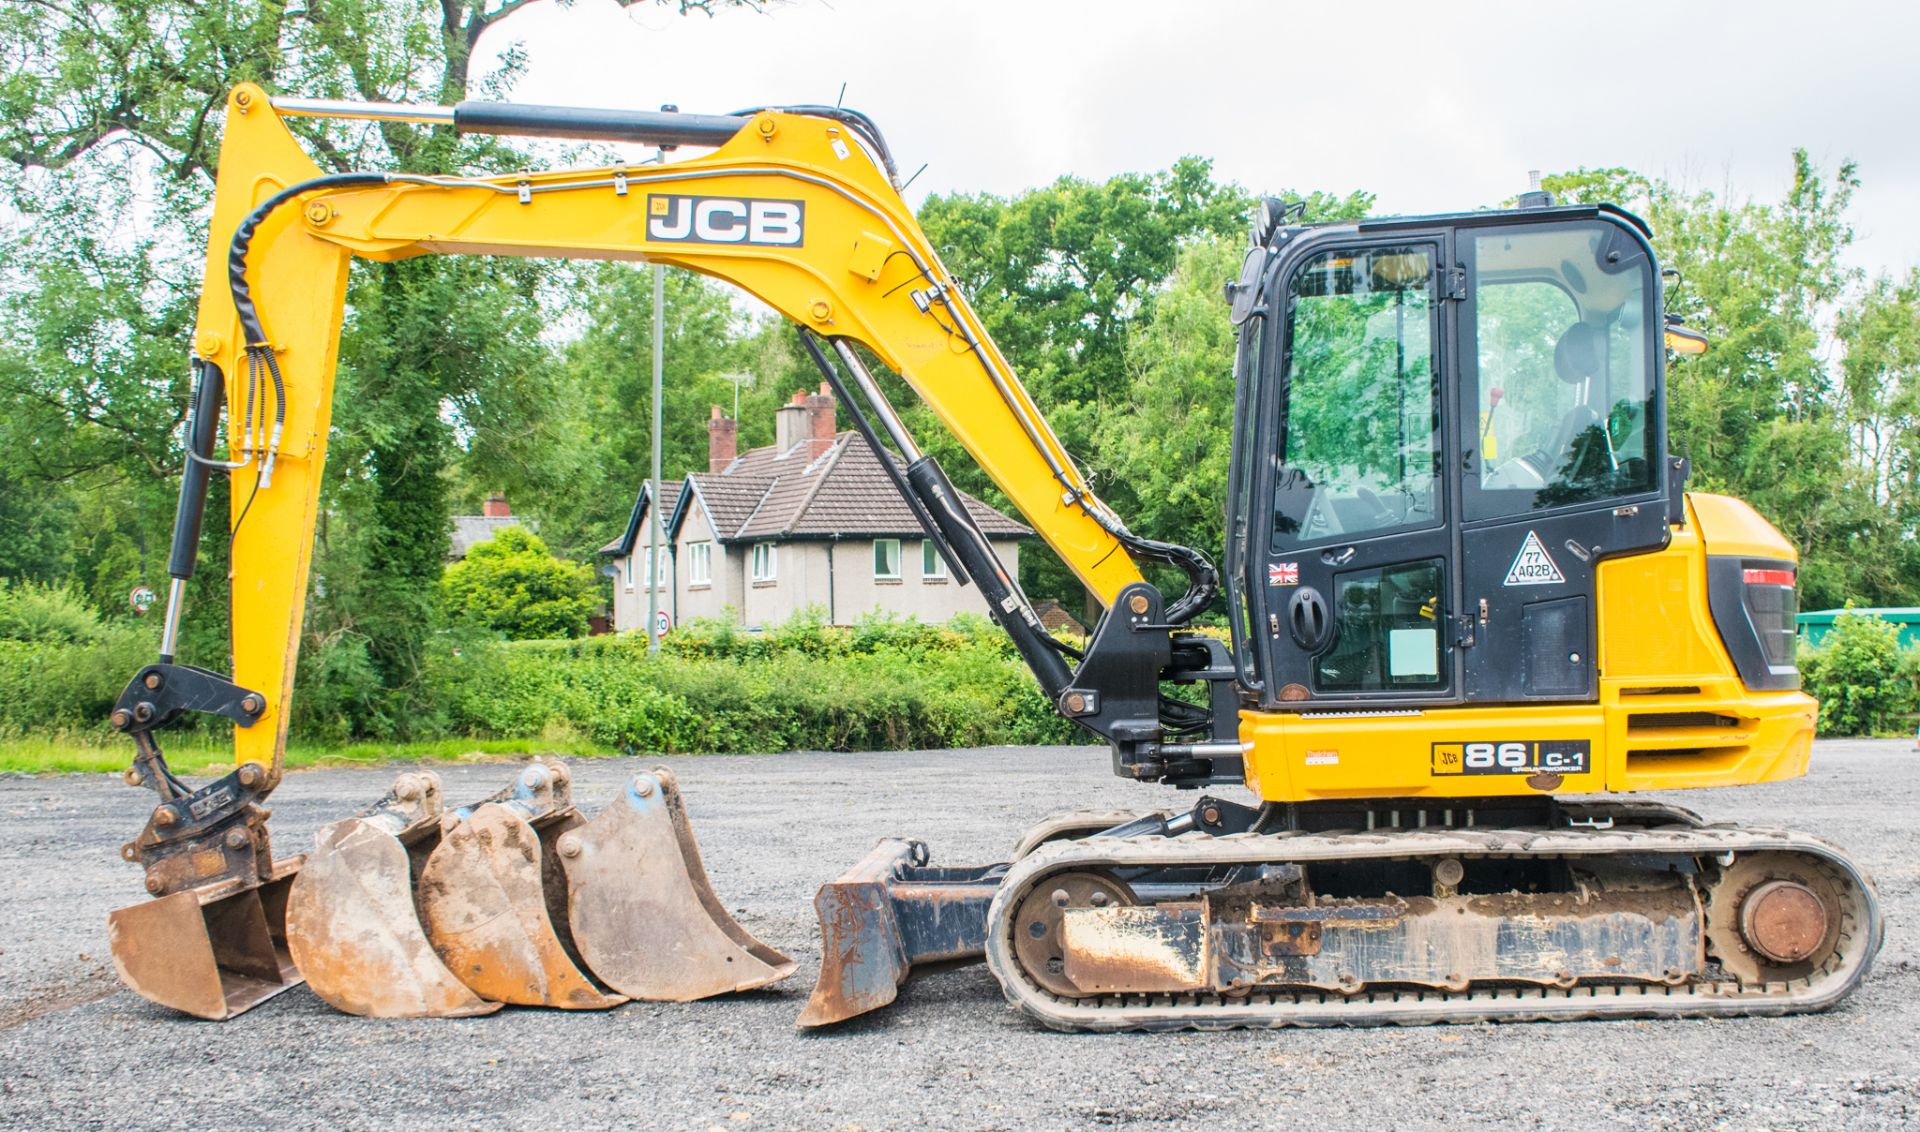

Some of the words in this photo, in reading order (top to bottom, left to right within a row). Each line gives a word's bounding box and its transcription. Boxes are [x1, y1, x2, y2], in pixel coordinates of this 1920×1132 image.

[650, 198, 801, 244] JCB
[1525, 551, 1541, 563] 77
[1518, 564, 1551, 577] AQ2B
[1441, 751, 1459, 765] JCB
[1465, 743, 1527, 767] 86
[1545, 753, 1584, 766] C-1
